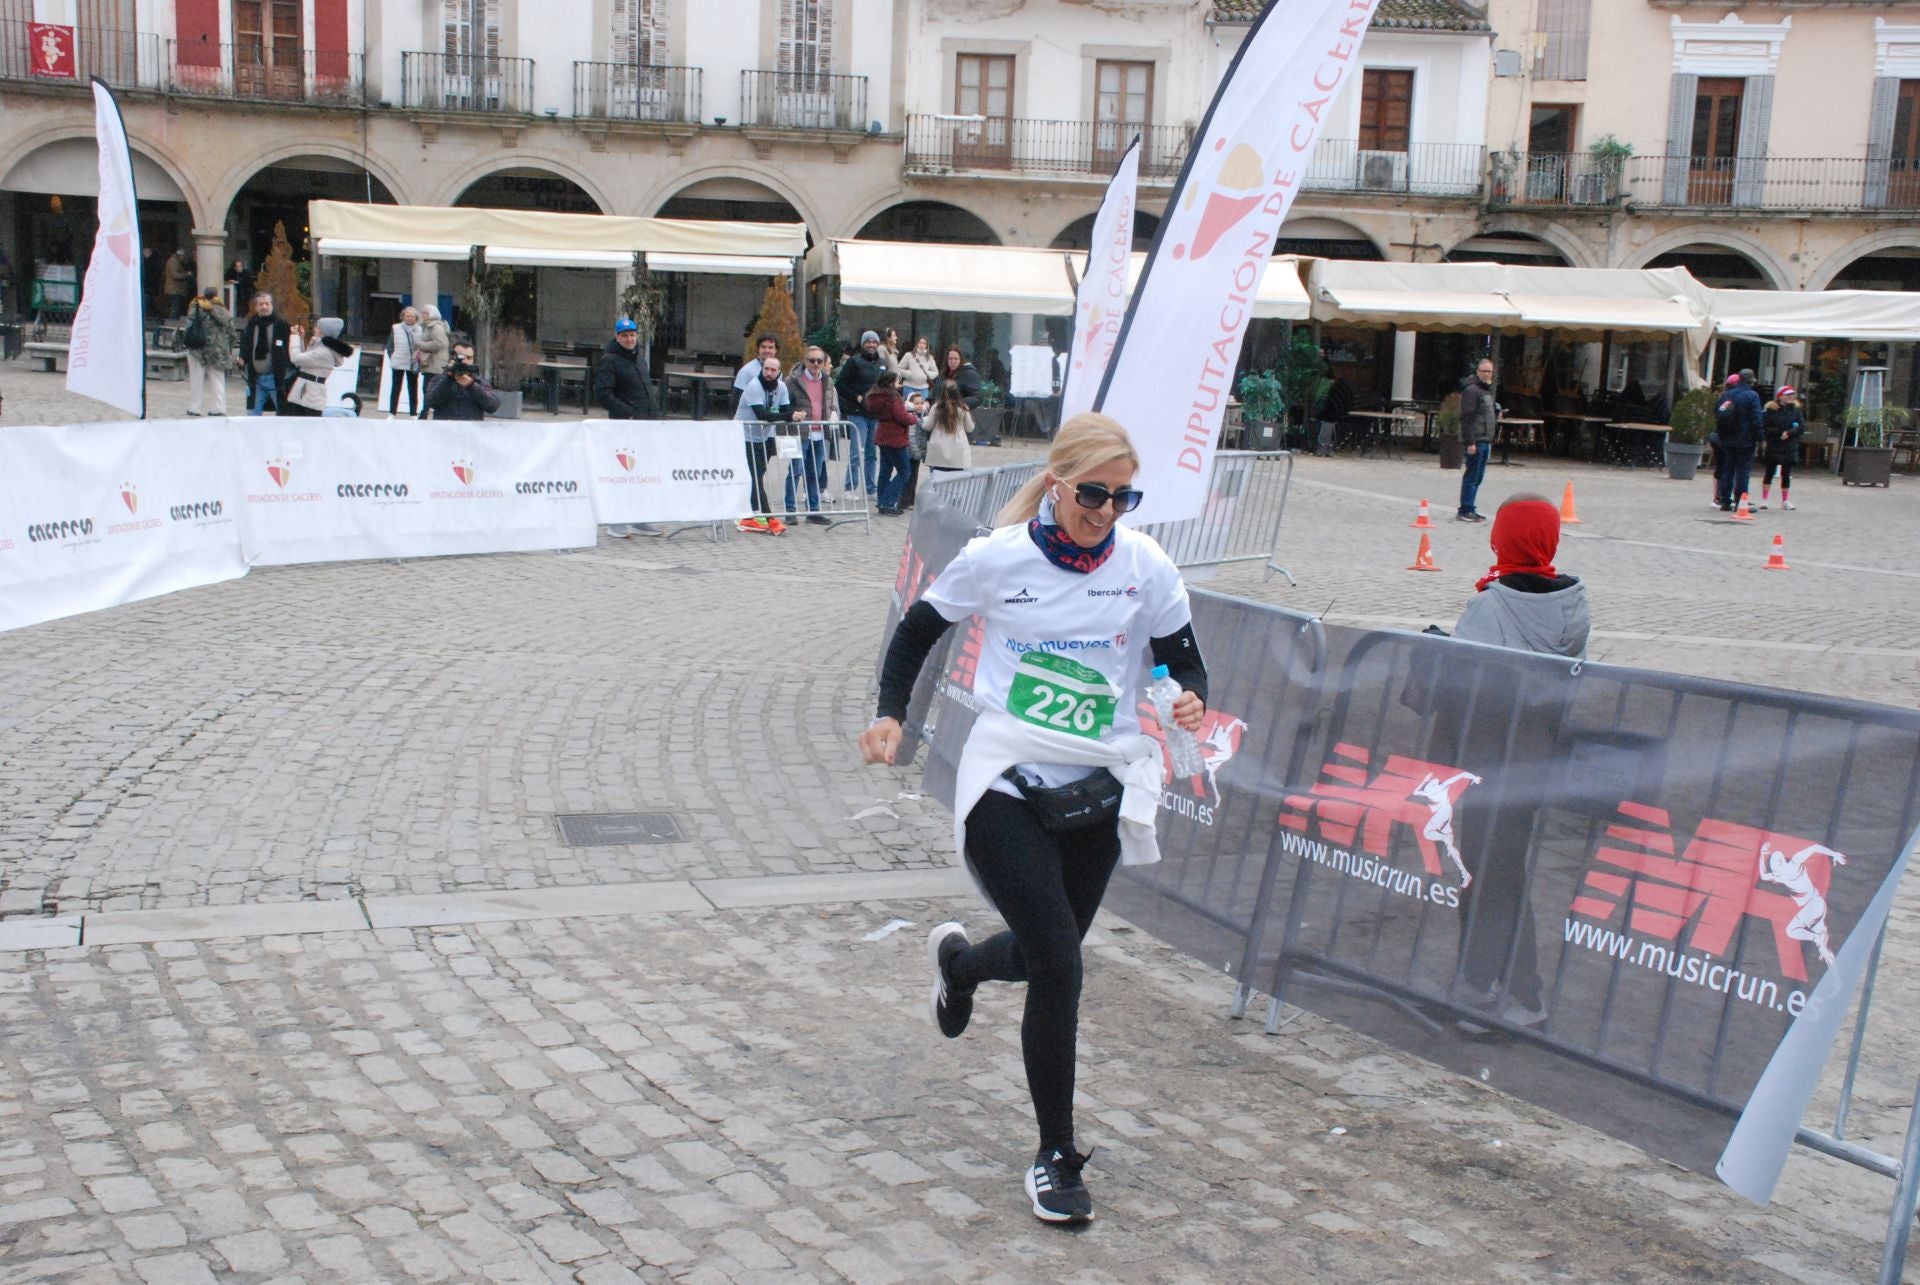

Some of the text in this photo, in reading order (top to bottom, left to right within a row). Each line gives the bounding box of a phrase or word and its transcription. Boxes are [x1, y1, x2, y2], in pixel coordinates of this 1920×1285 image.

[1176, 231, 1270, 475] DIPUTACIÓN
[1262, 167, 1296, 216] DE
[1006, 637, 1034, 653] Nos
[1024, 684, 1097, 732] 226
[1279, 830, 1460, 908] www.musicrun.es
